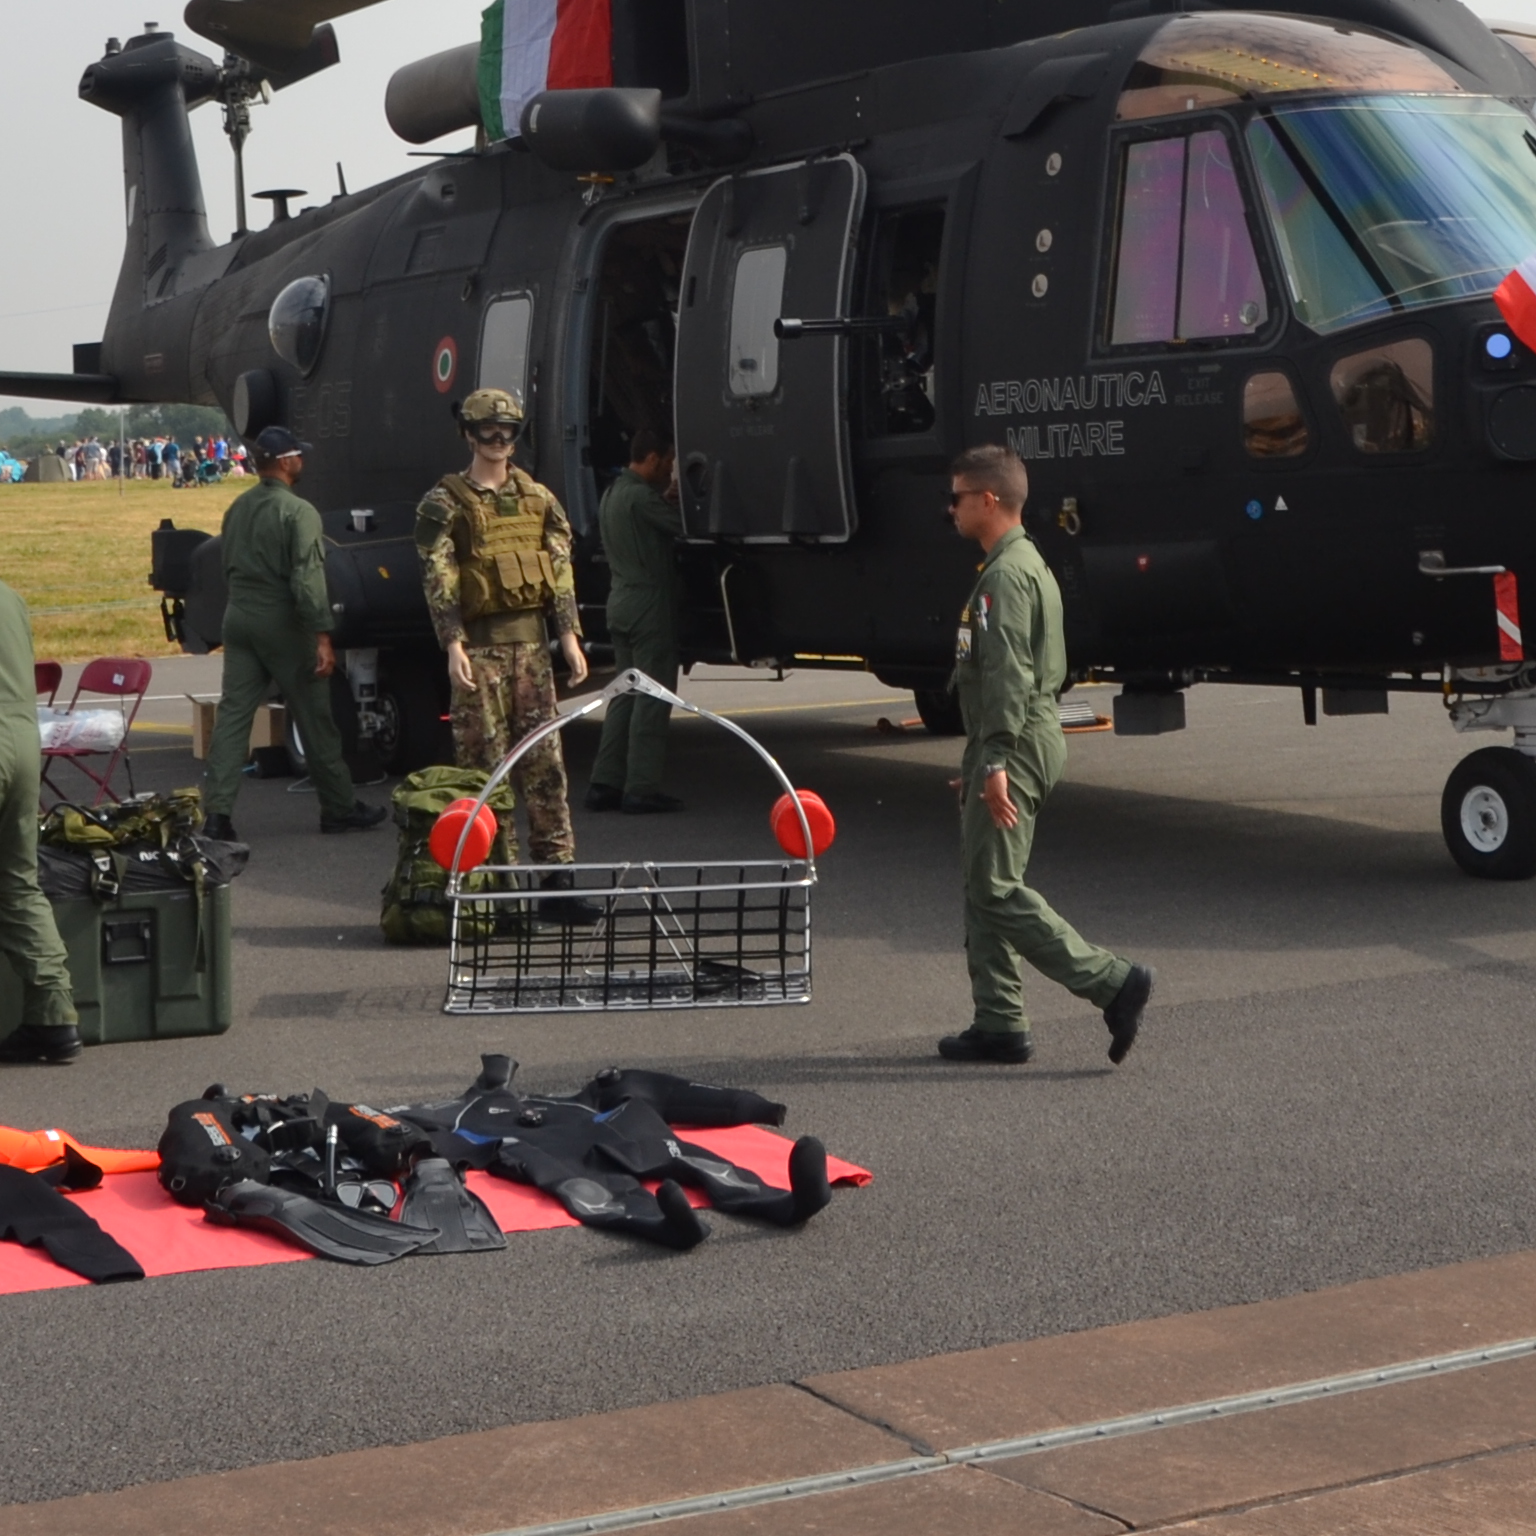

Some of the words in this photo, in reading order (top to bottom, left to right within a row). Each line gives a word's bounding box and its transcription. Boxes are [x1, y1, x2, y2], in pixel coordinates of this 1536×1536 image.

[974, 370, 1167, 417] AERONAUTICA
[1187, 377, 1211, 391] EXIT
[1174, 391, 1224, 406] RELEASE
[1006, 420, 1125, 460] MILITARE
